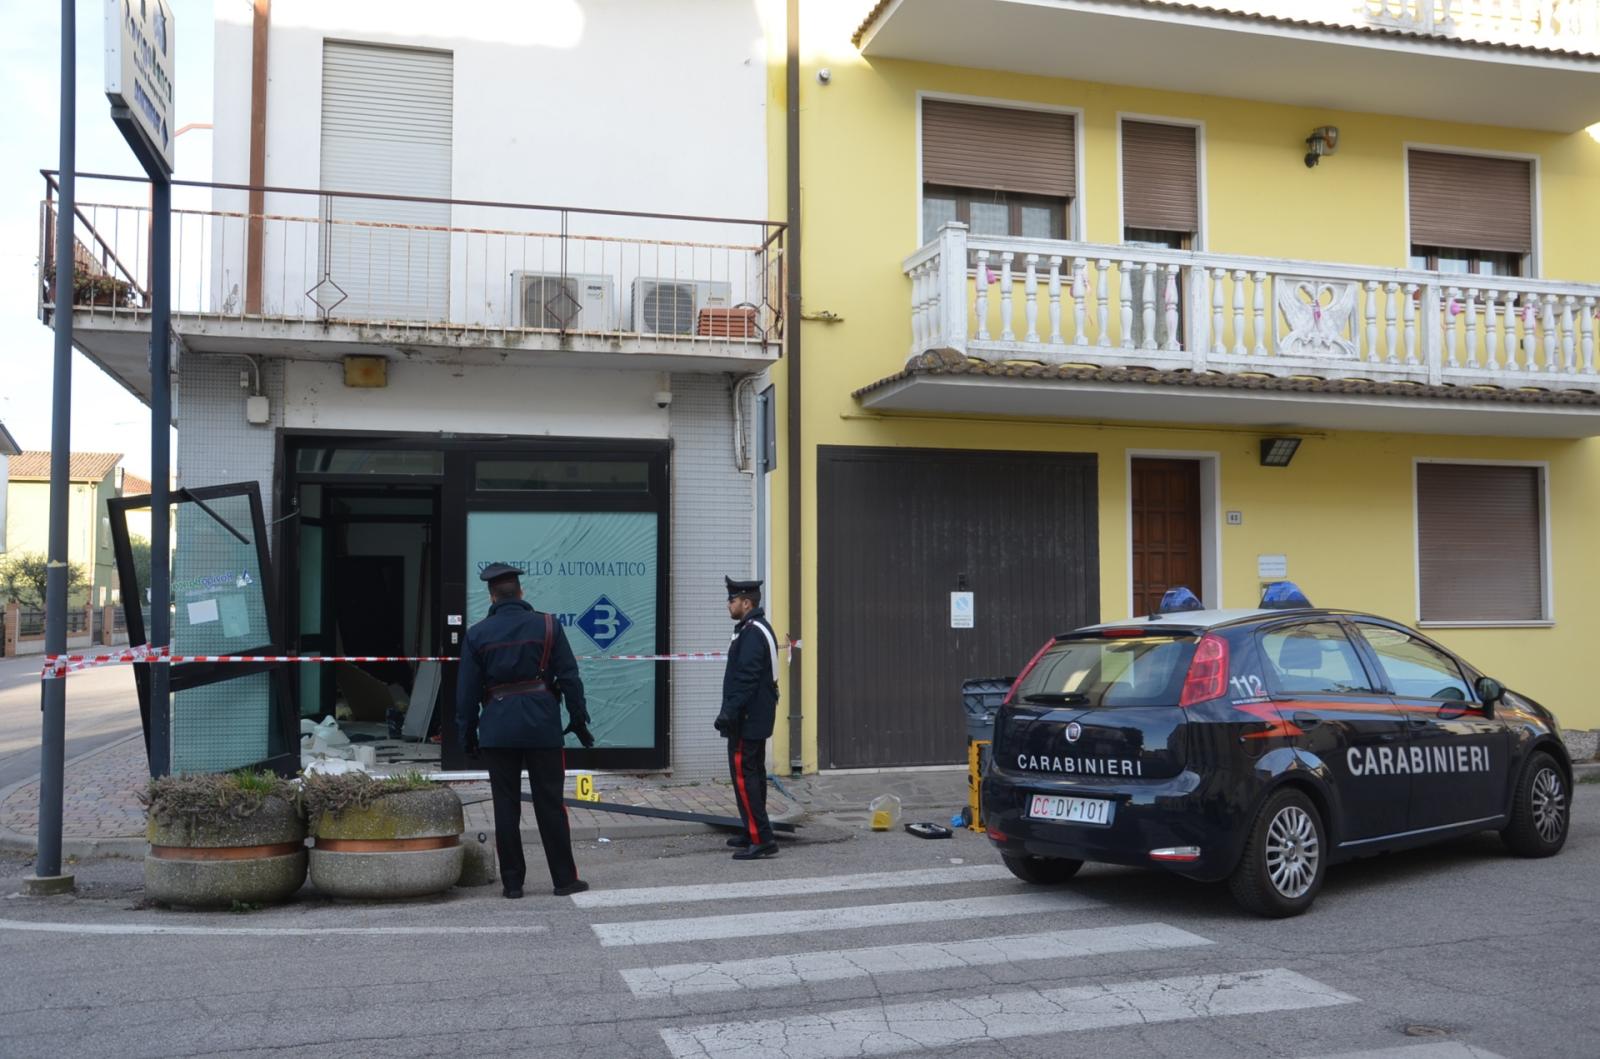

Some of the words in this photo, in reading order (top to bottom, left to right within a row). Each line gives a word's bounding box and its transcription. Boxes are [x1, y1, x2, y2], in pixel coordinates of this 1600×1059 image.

[558, 561, 646, 577] AUTOMATICO
[1229, 675, 1268, 697] 112
[1017, 753, 1142, 776] CARABINIERI
[1346, 745, 1490, 776] CARABINIERI
[580, 777, 590, 796] C
[1033, 797, 1050, 815] CC
[1056, 798, 1074, 817] DV
[1079, 800, 1104, 821] 101
